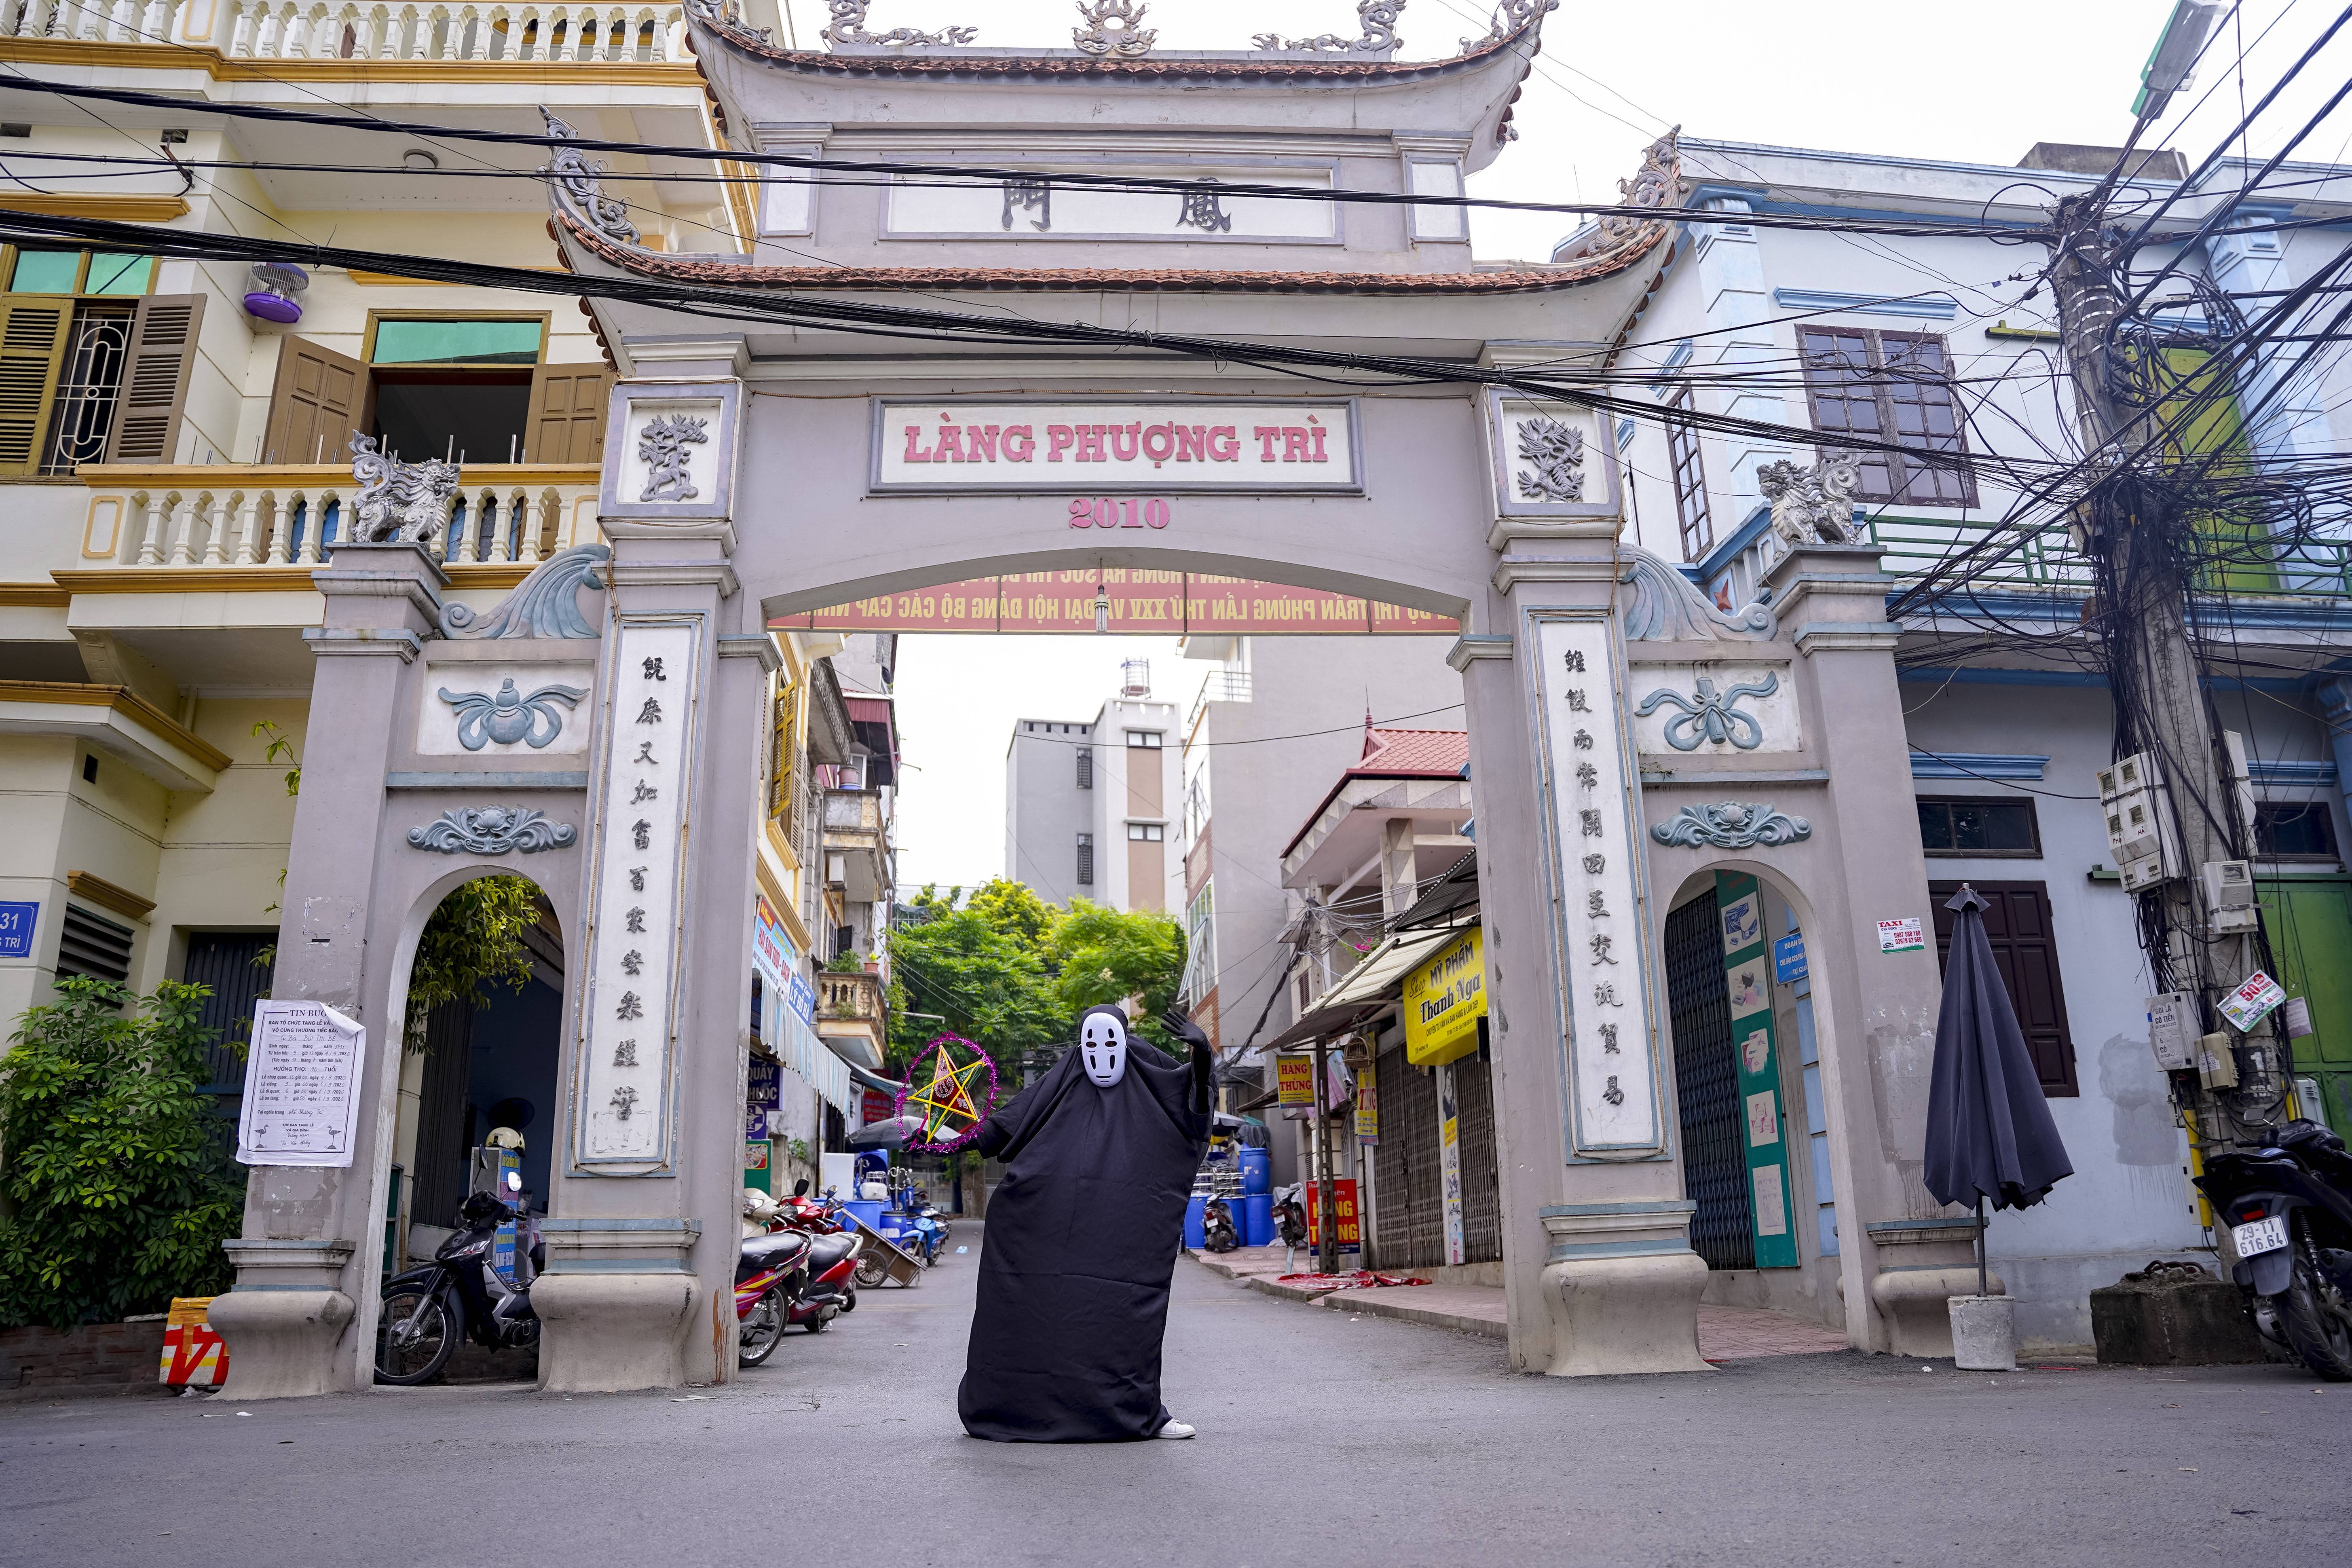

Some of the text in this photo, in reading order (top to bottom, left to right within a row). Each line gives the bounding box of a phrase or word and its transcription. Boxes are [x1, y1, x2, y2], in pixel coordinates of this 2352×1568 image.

[904, 412, 1329, 468] LÀNG PHƯỢNG TRÌ
[1069, 498, 1170, 528] 2010
[5, 935, 21, 948] TRÌ
[1430, 937, 1475, 988] MỸ PHẨM
[1410, 975, 1426, 998] Shop
[2239, 984, 2261, 1002] 50
[2261, 981, 2273, 991] TRIỆU
[1420, 985, 1454, 1025] Thanh
[1456, 972, 1481, 1004] Nga
[1281, 1062, 1308, 1075] HÀNG
[748, 1082, 777, 1100] HUỐC
[1279, 1078, 1312, 1091] THÙNG
[2240, 1220, 2275, 1240] 29-T1
[2240, 1232, 2284, 1255] 616.64
